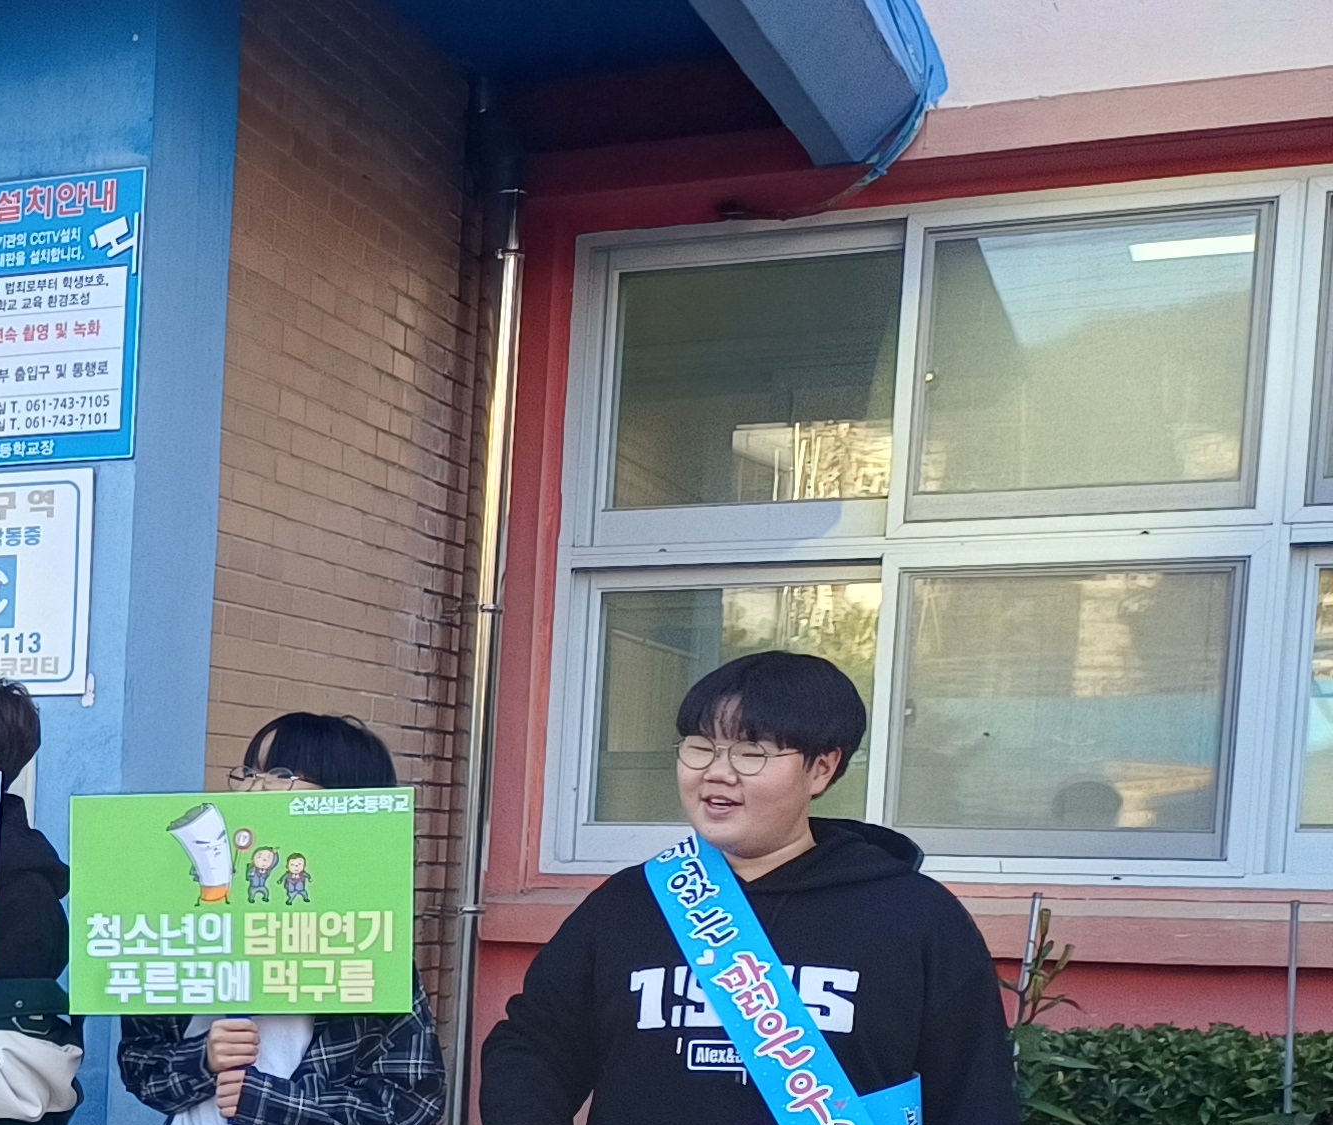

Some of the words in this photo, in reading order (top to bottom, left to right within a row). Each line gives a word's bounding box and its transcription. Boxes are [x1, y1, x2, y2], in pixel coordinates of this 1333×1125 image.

[29, 246, 85, 265] 설치합니다.
[5, 278, 58, 295] 범죄로부터
[22, 296, 43, 310] 교육
[47, 291, 91, 308] 환경조성
[22, 324, 50, 342] 촬영
[55, 322, 68, 339] 및
[73, 319, 101, 337] 녹화
[14, 364, 50, 382] 출입구
[55, 364, 67, 378] 및
[72, 360, 109, 377] 통행로
[26, 395, 110, 413] 061-743-7105
[25, 412, 107, 429] 061-743-7101
[288, 793, 410, 815] 순천성남초등학교
[85, 910, 233, 958] 청소년의
[243, 909, 394, 956] 담배연기
[105, 960, 251, 1005] 푸른꿈에
[261, 958, 376, 1004] 먹구름
